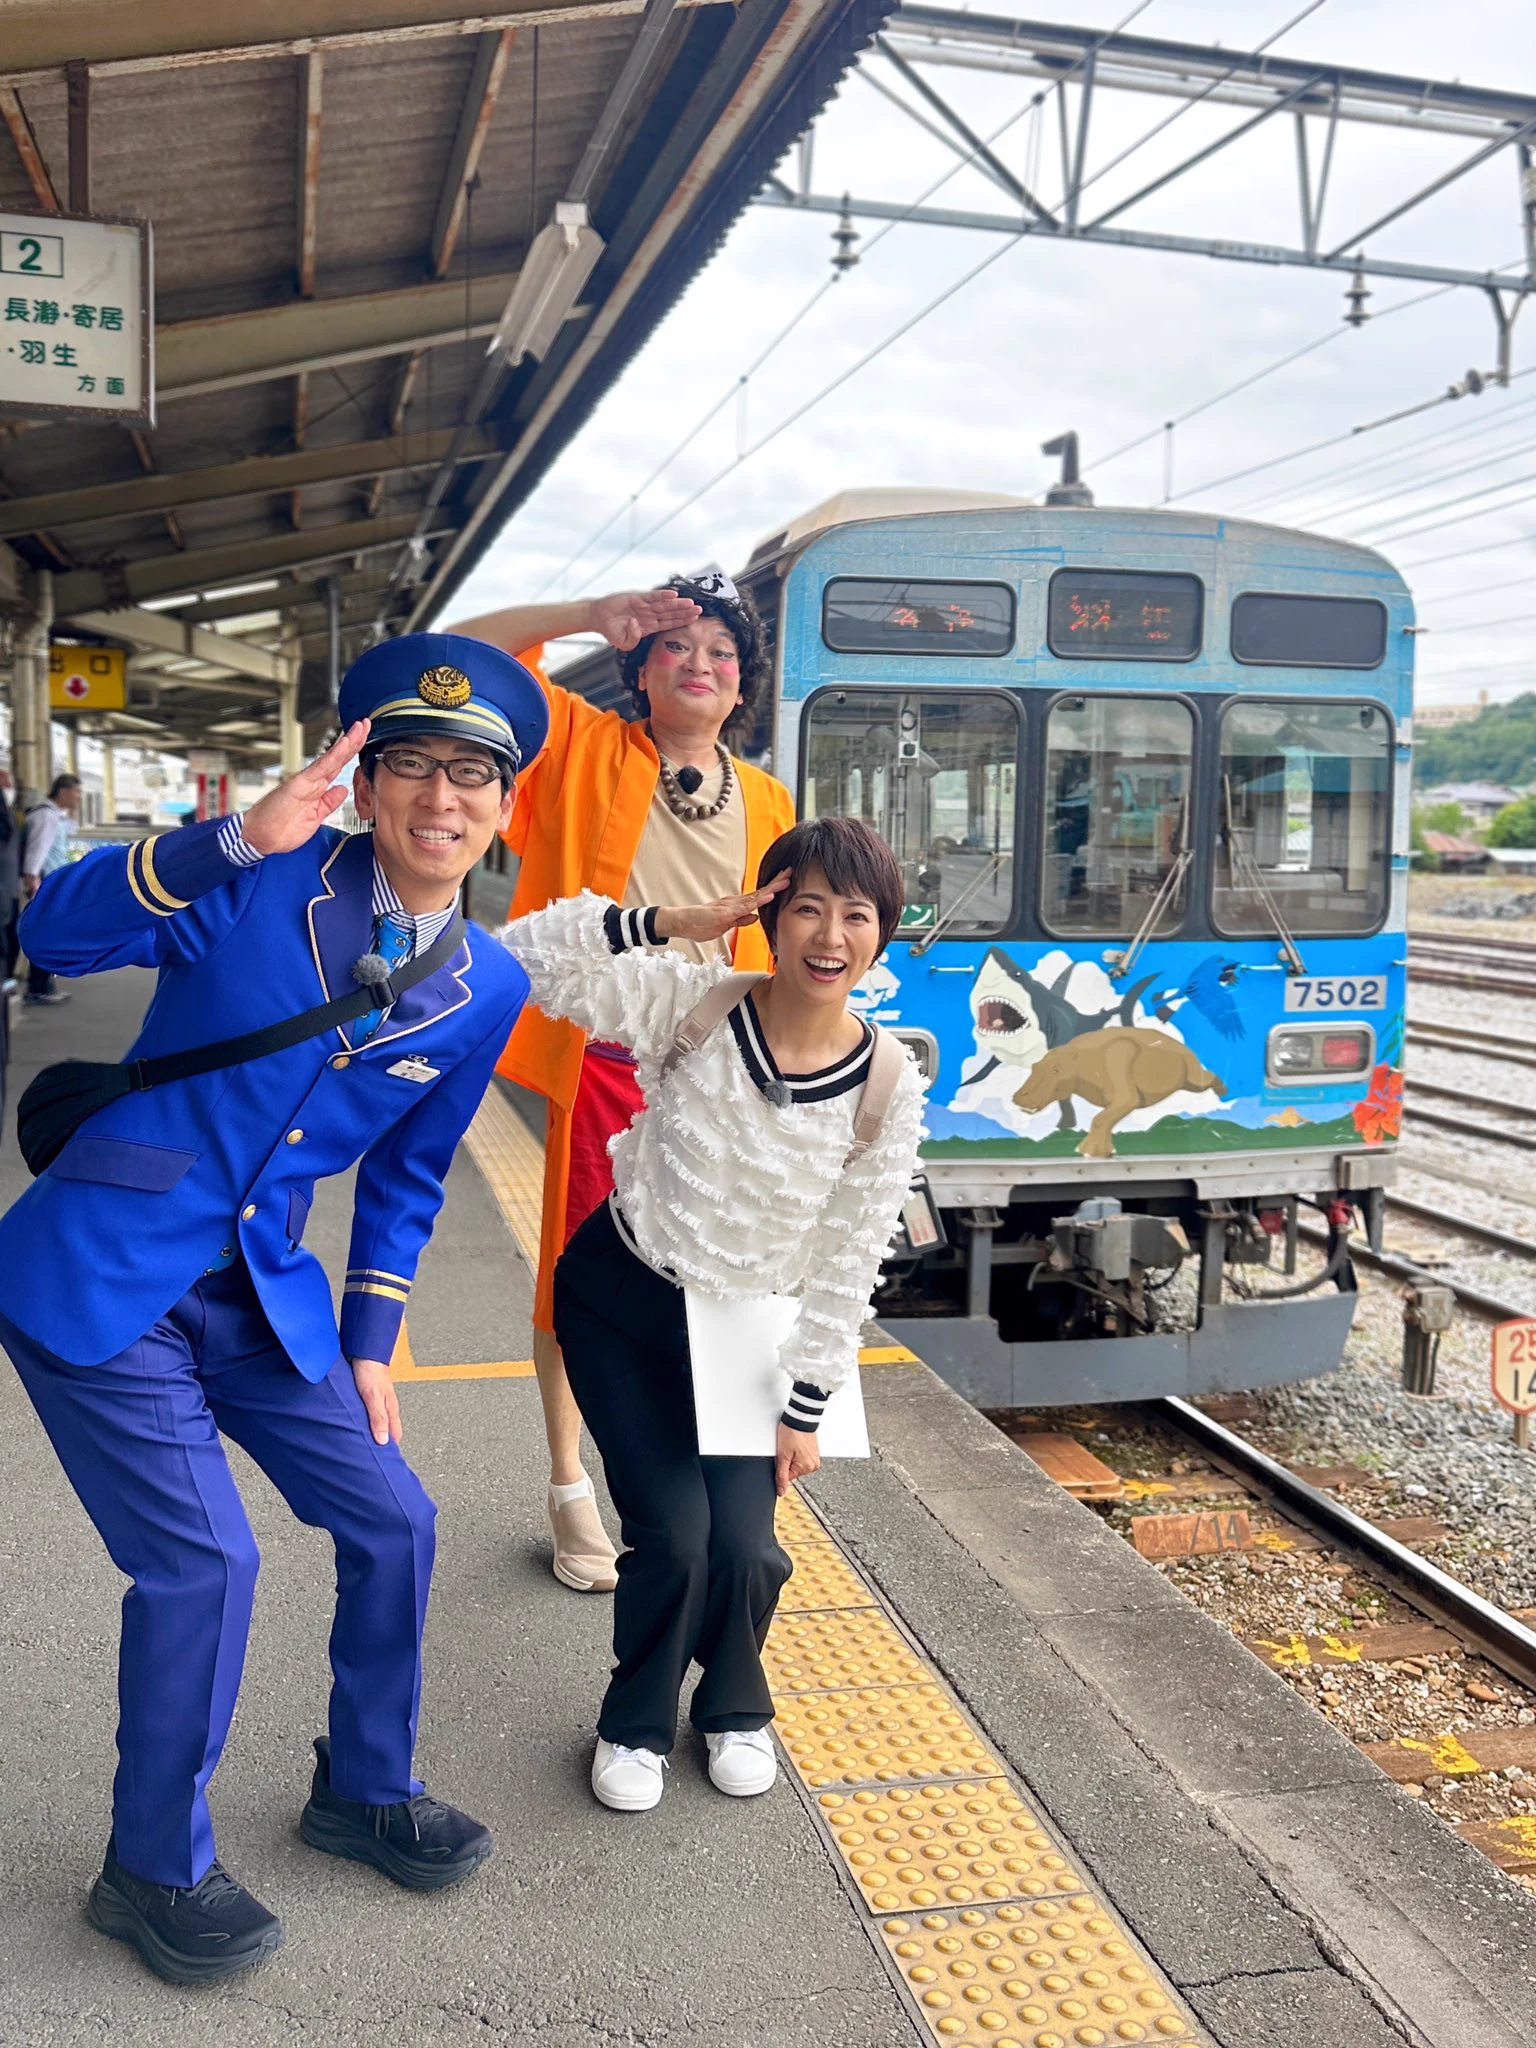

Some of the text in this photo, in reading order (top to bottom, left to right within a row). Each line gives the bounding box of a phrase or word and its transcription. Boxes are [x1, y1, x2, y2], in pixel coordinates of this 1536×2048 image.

[19, 239, 42, 271] 2
[77, 374, 125, 395] 方面
[1293, 980, 1379, 1008] 7502
